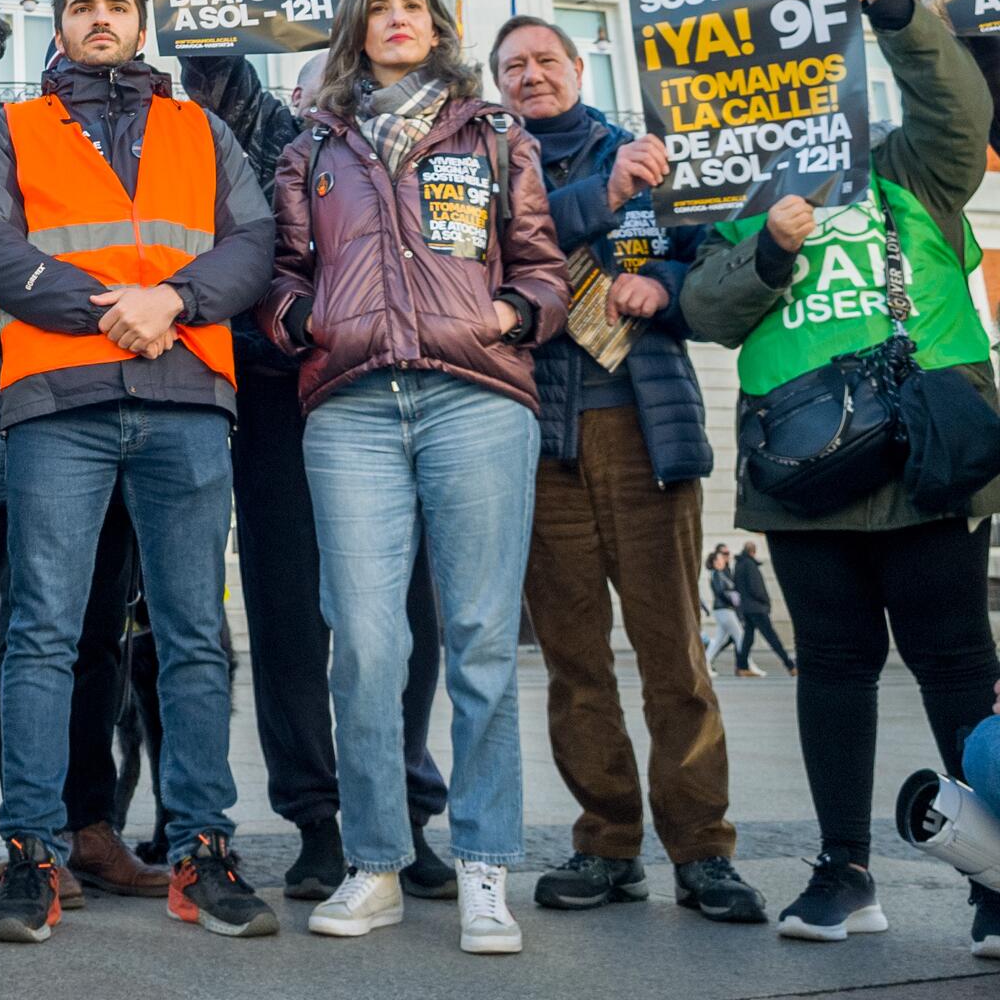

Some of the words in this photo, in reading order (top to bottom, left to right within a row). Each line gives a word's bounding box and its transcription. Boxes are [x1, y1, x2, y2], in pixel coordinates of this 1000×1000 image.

[174, 8, 198, 31] A
[199, 4, 259, 29] SOL
[642, 7, 755, 72] ¡YA!
[660, 53, 847, 107] ¡TOMAMOS
[671, 103, 721, 132] LA
[722, 84, 839, 126] CALLE!
[665, 131, 712, 161] DE
[715, 112, 852, 156] ATOCHA
[428, 157, 480, 168] VIVIENDA
[434, 165, 470, 174] DIGNA
[471, 167, 478, 176] Y
[672, 162, 700, 190] A
[701, 154, 772, 187] SOL
[796, 141, 850, 174] 12H
[423, 172, 489, 188] SOSTENIBLE
[424, 184, 464, 200] ¡YA!
[468, 188, 490, 206] 9F
[432, 211, 450, 220] LA
[429, 220, 447, 230] DE
[448, 221, 487, 239] ATOCHA
[432, 230, 441, 240] A
